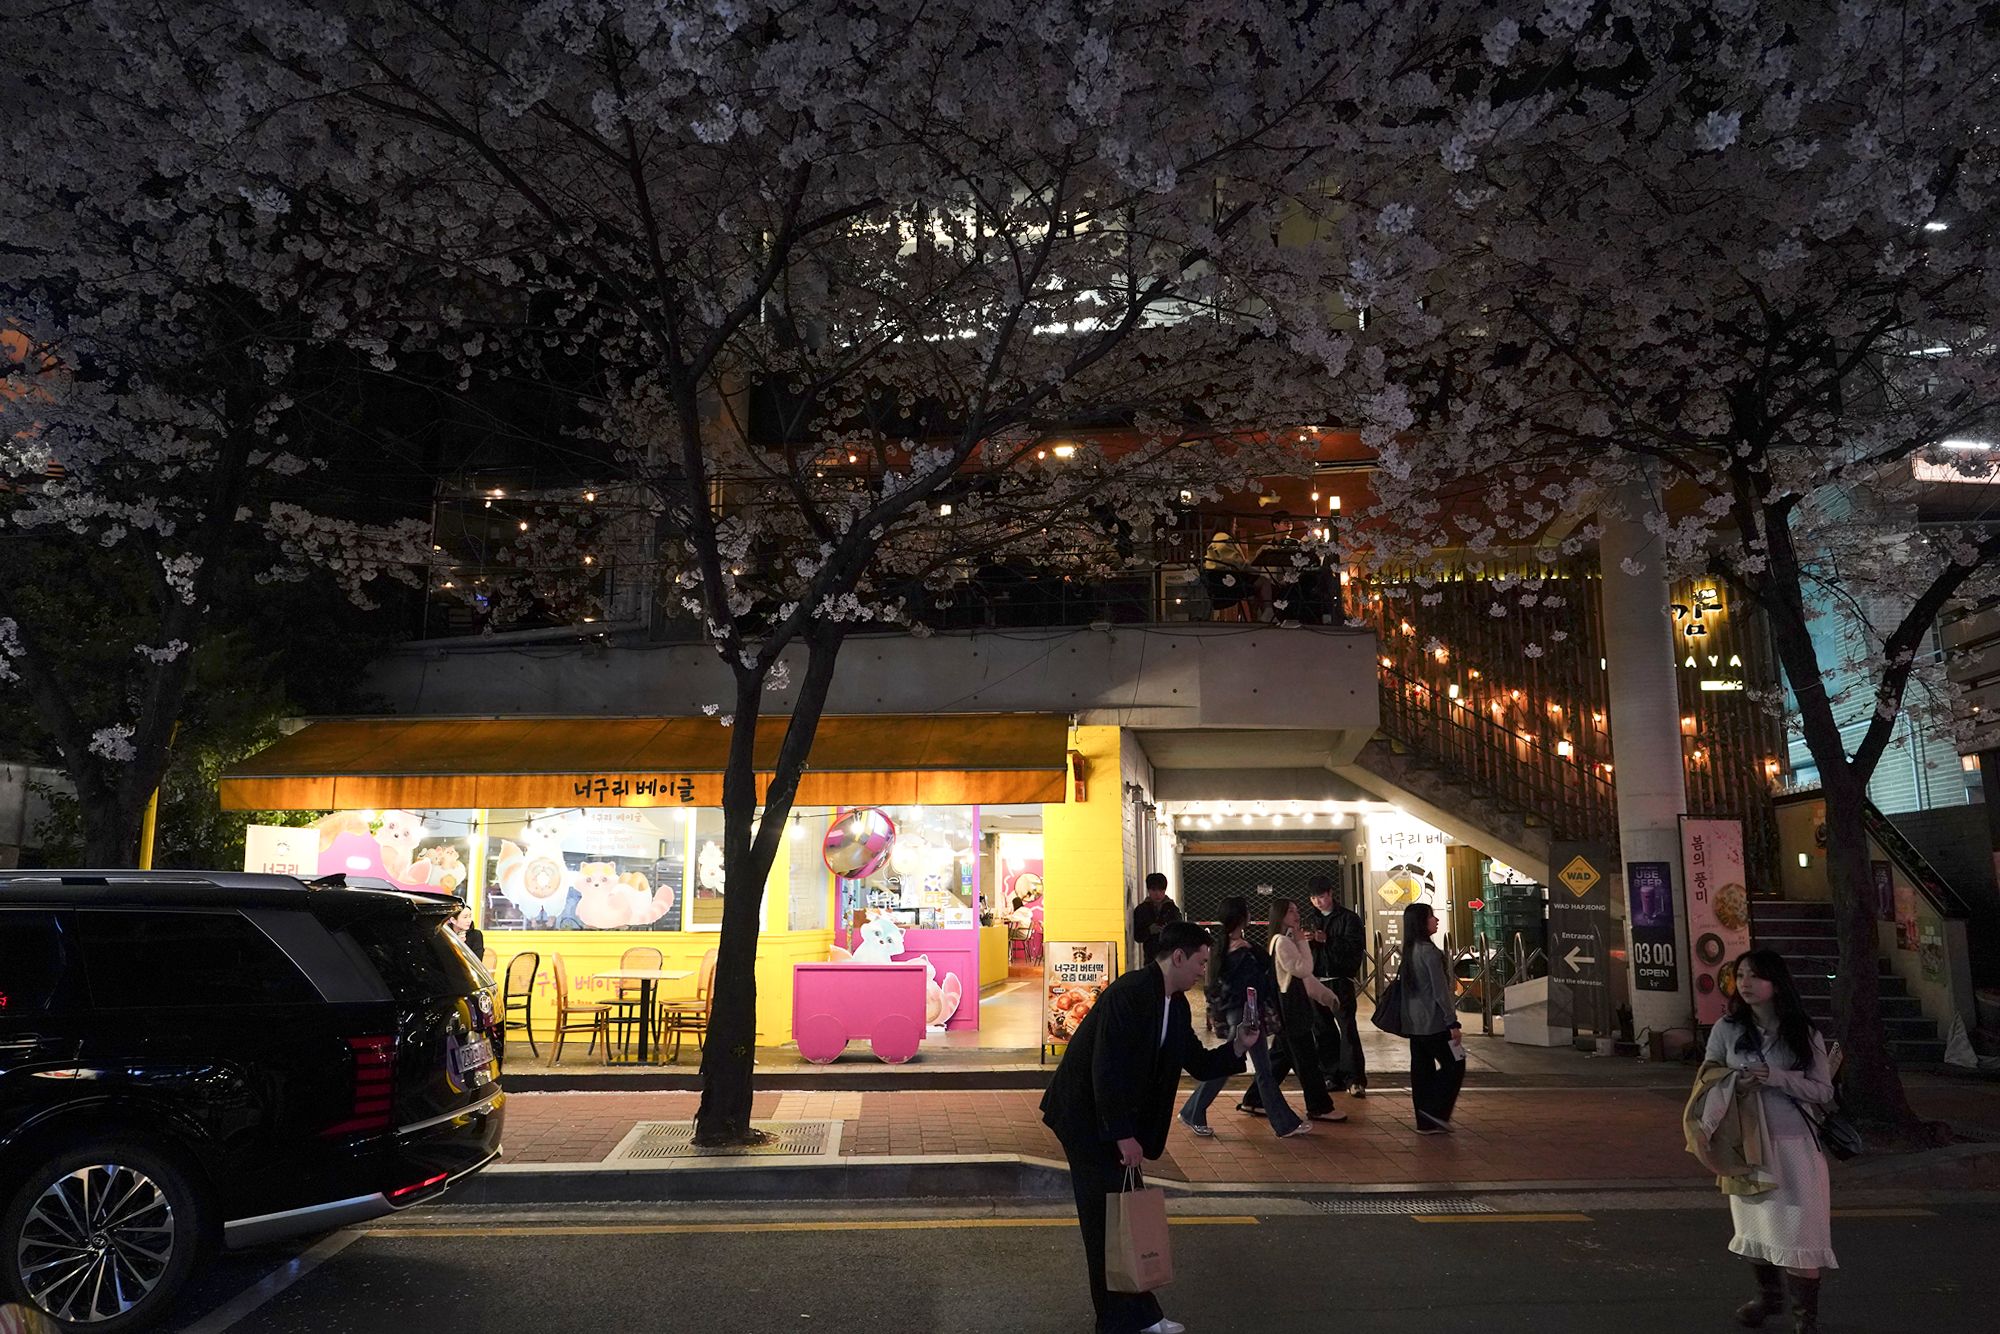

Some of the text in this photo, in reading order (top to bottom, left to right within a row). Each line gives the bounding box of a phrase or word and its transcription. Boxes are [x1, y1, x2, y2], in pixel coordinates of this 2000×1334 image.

[574, 778, 695, 803] 너구리 베이글
[1380, 832, 1420, 849] 너구리
[1635, 870, 1659, 879] UBE
[1691, 834, 1708, 905] 봄의 풍미
[1567, 871, 1591, 881] WAD
[1633, 878, 1663, 887] BEER
[1571, 903, 1606, 911] HAPJEONG
[1561, 931, 1595, 941] Entrance
[1054, 963, 1104, 973] 너구리 버터떡
[1639, 968, 1669, 978] OPEN
[1061, 973, 1097, 982] 요즘 대세!
